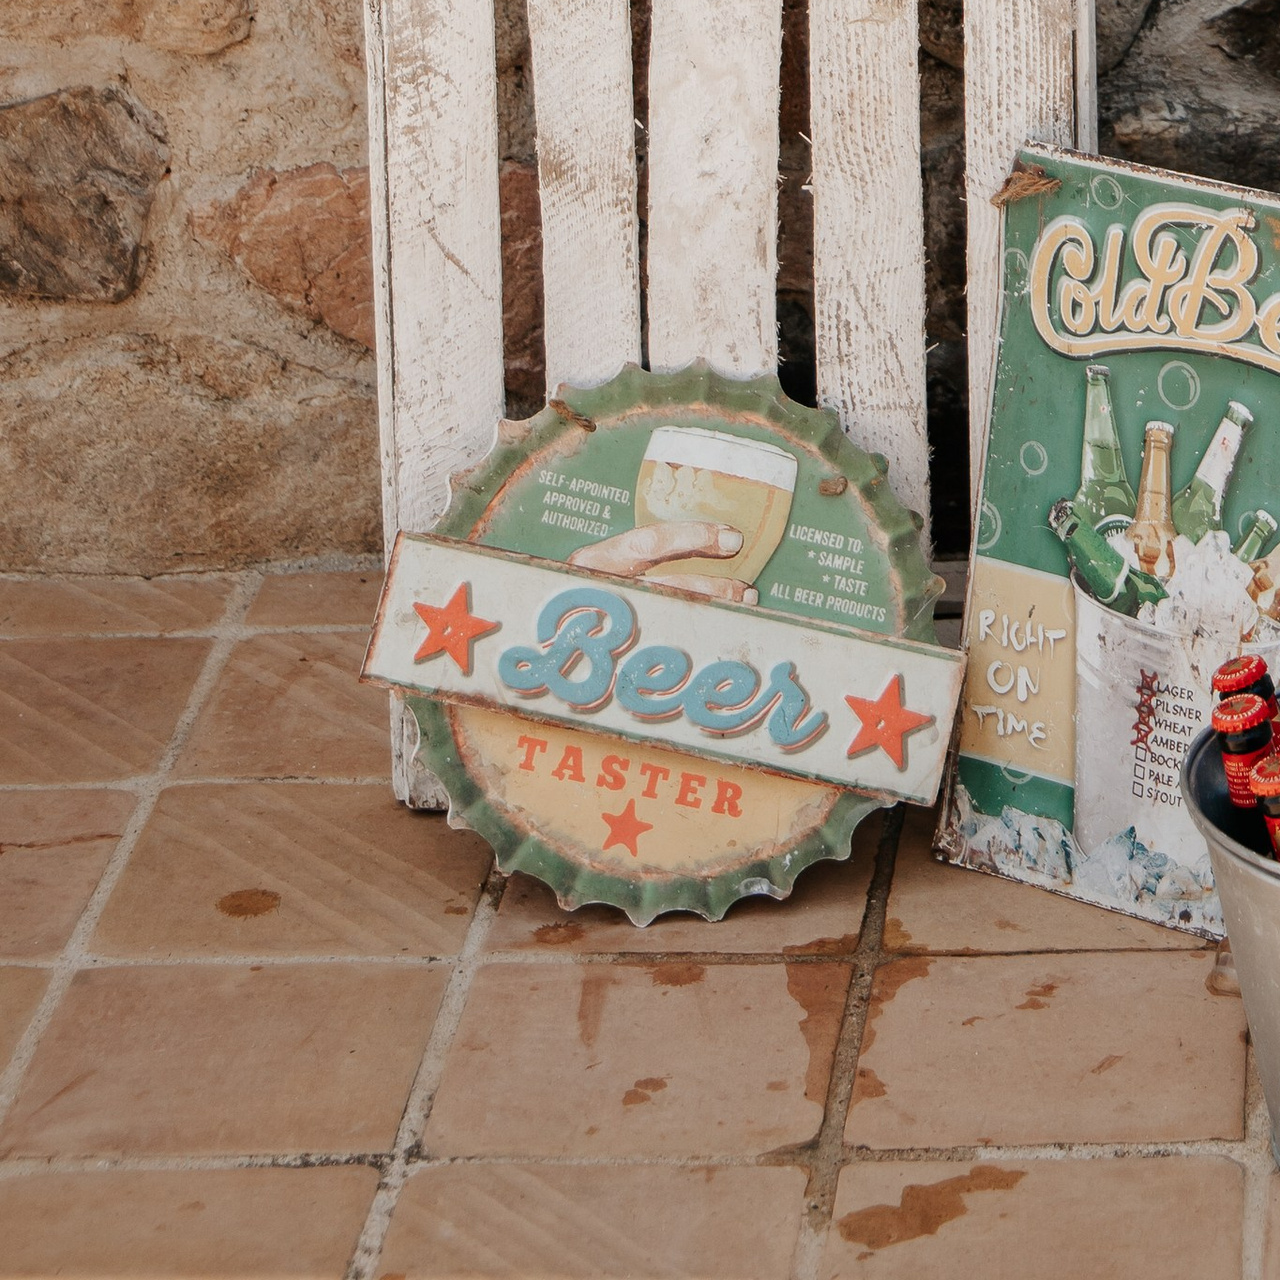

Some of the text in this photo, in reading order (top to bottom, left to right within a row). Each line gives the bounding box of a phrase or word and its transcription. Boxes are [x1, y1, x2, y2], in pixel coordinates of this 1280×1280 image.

[539, 470, 631, 506] SELF-APPOINTED,
[543, 491, 611, 519] APPROVED &
[541, 509, 609, 537] AUTHORIZED
[789, 524, 864, 554] LICENSED TO:
[818, 551, 864, 575] SAMPLE
[834, 575, 869, 596] TASTE
[770, 582, 886, 622] ALL BEER PRODUCTS
[979, 608, 1067, 660] RIGHT
[497, 586, 829, 754] Beer
[987, 660, 1040, 702] ON
[1156, 681, 1194, 702] LAGER
[1155, 698, 1202, 722] PILSNER
[971, 704, 1050, 751] TIME
[1153, 715, 1193, 737] WHEAT
[1151, 734, 1190, 754] AMBER
[1150, 751, 1181, 771] BOCK
[517, 735, 743, 818] TASTER
[1149, 769, 1173, 785] PALE
[1147, 788, 1182, 807] STOUT
